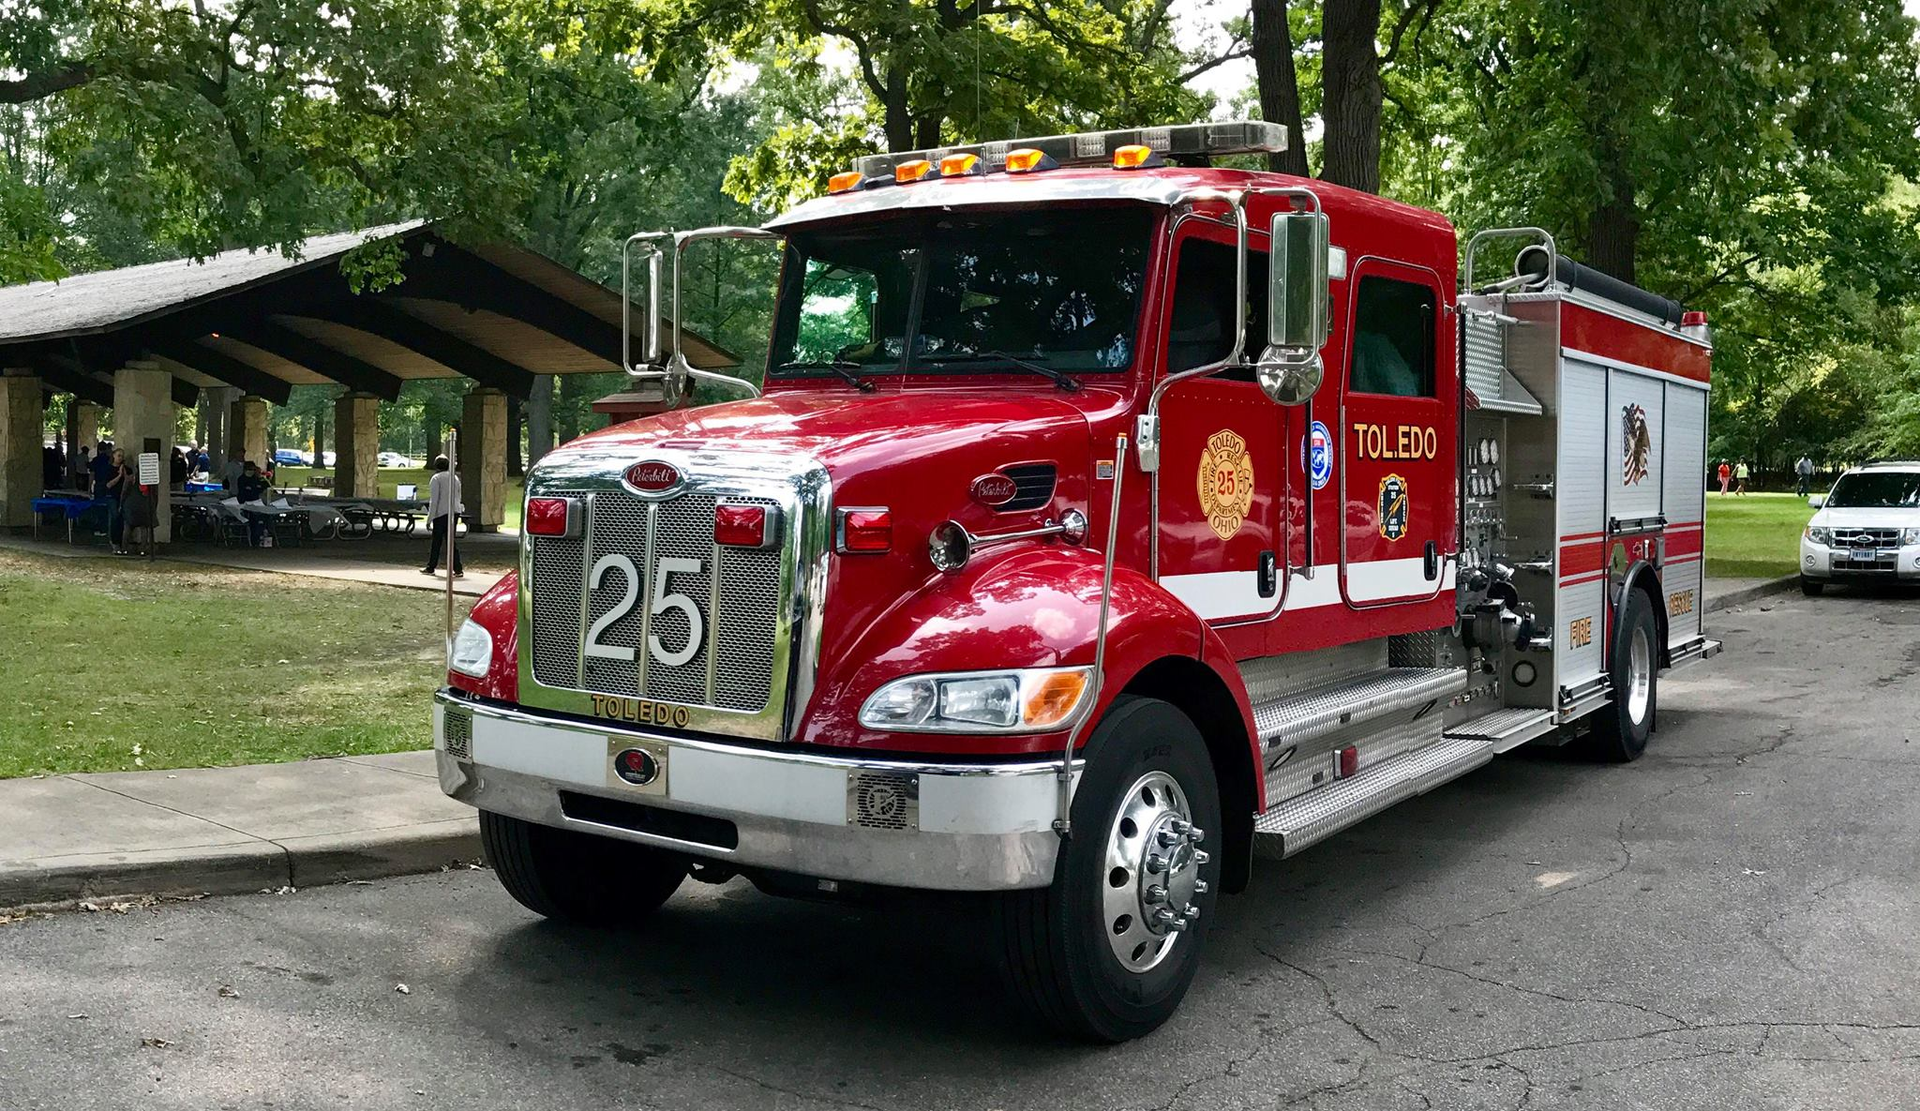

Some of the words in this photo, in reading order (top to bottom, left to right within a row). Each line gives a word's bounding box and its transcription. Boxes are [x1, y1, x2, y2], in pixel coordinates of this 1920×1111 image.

[1210, 433, 1241, 455] TOLEDO
[1353, 423, 1438, 460] TOLEDO
[632, 466, 675, 483] Peterbilt
[1217, 470, 1235, 496] 25
[978, 480, 1013, 498] Peterbilt
[1212, 515, 1239, 534] OHIO
[584, 553, 703, 667] 25
[1570, 616, 1592, 650] FIRE
[590, 694, 690, 728] TOLEDO
